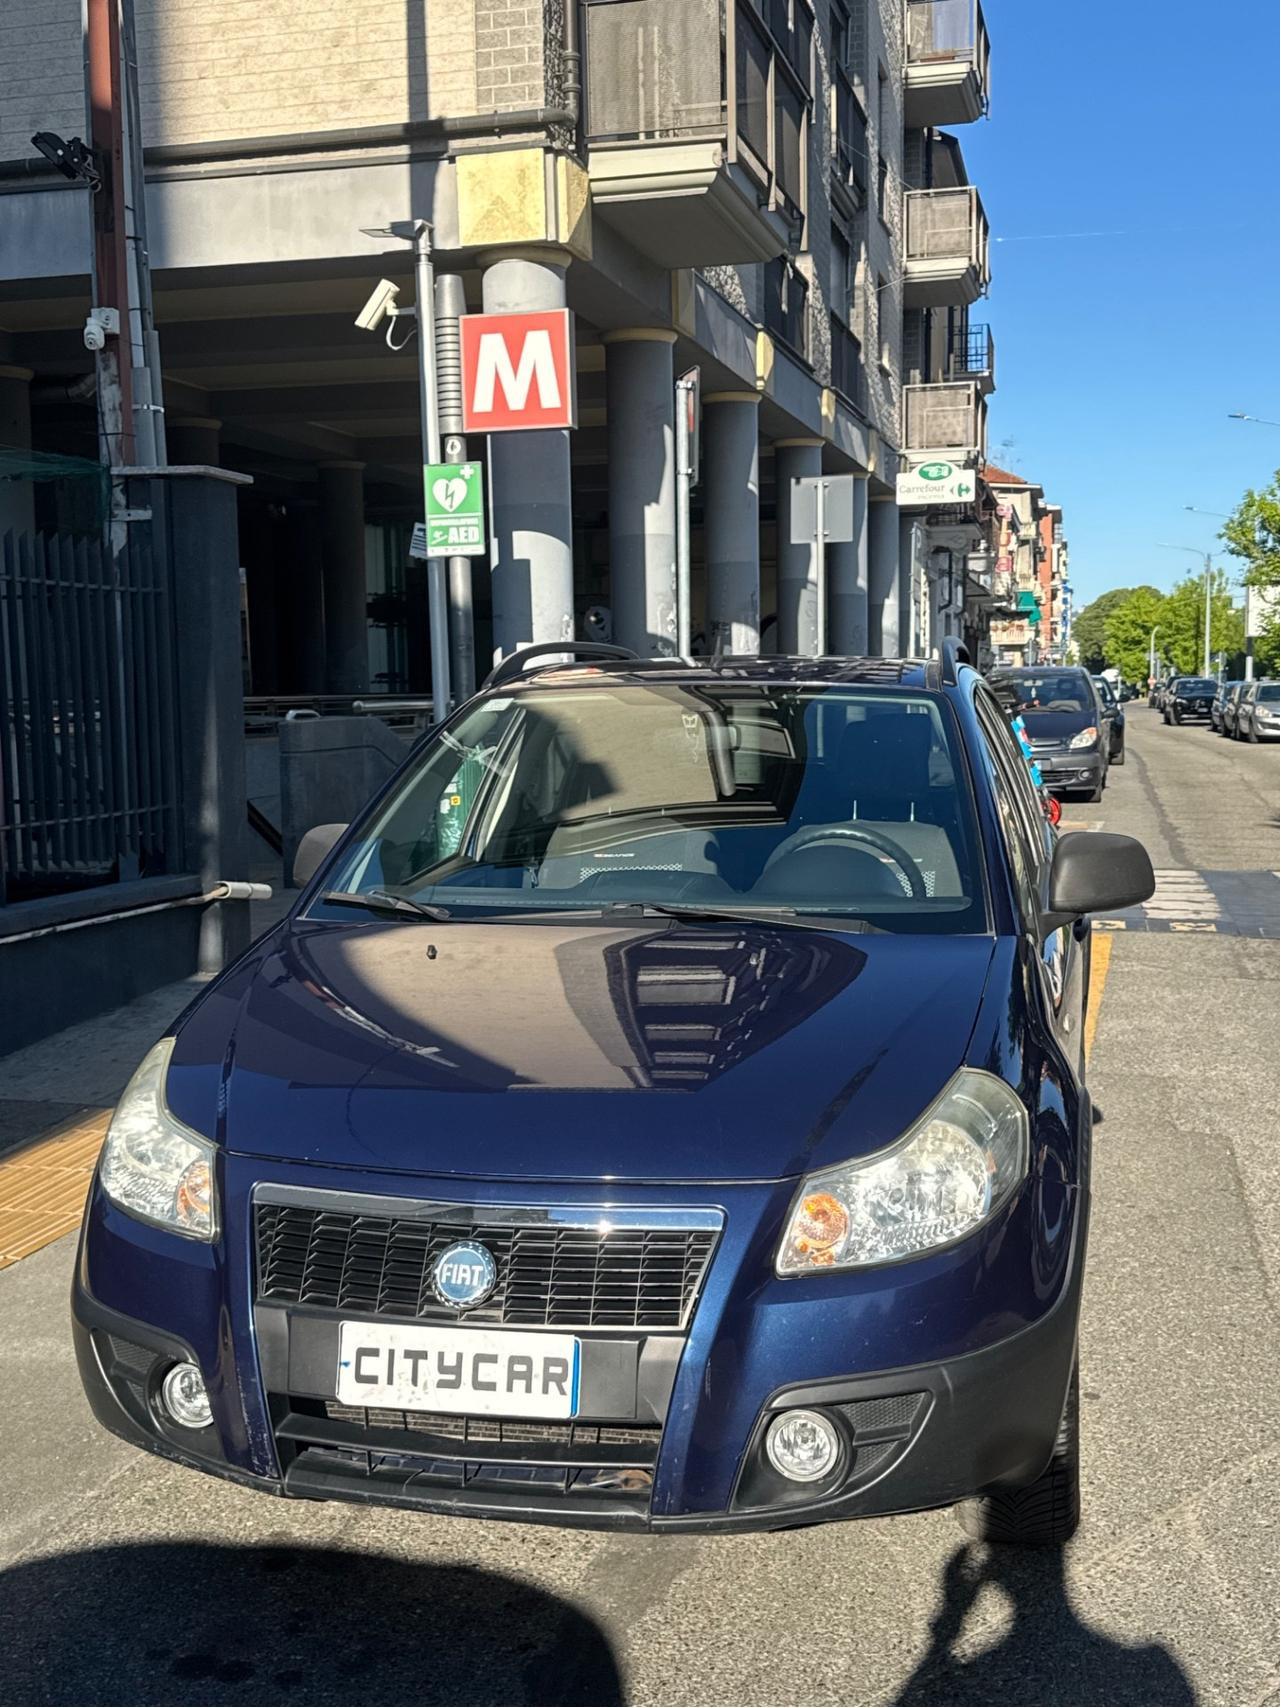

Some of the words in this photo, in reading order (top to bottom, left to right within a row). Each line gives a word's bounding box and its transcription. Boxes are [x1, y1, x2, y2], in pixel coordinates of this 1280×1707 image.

[473, 330, 561, 413] M
[899, 484, 945, 494] Carrefour
[448, 527, 480, 544] AED
[440, 1265, 482, 1286] FIAT
[354, 1347, 569, 1396] CITYCAR
